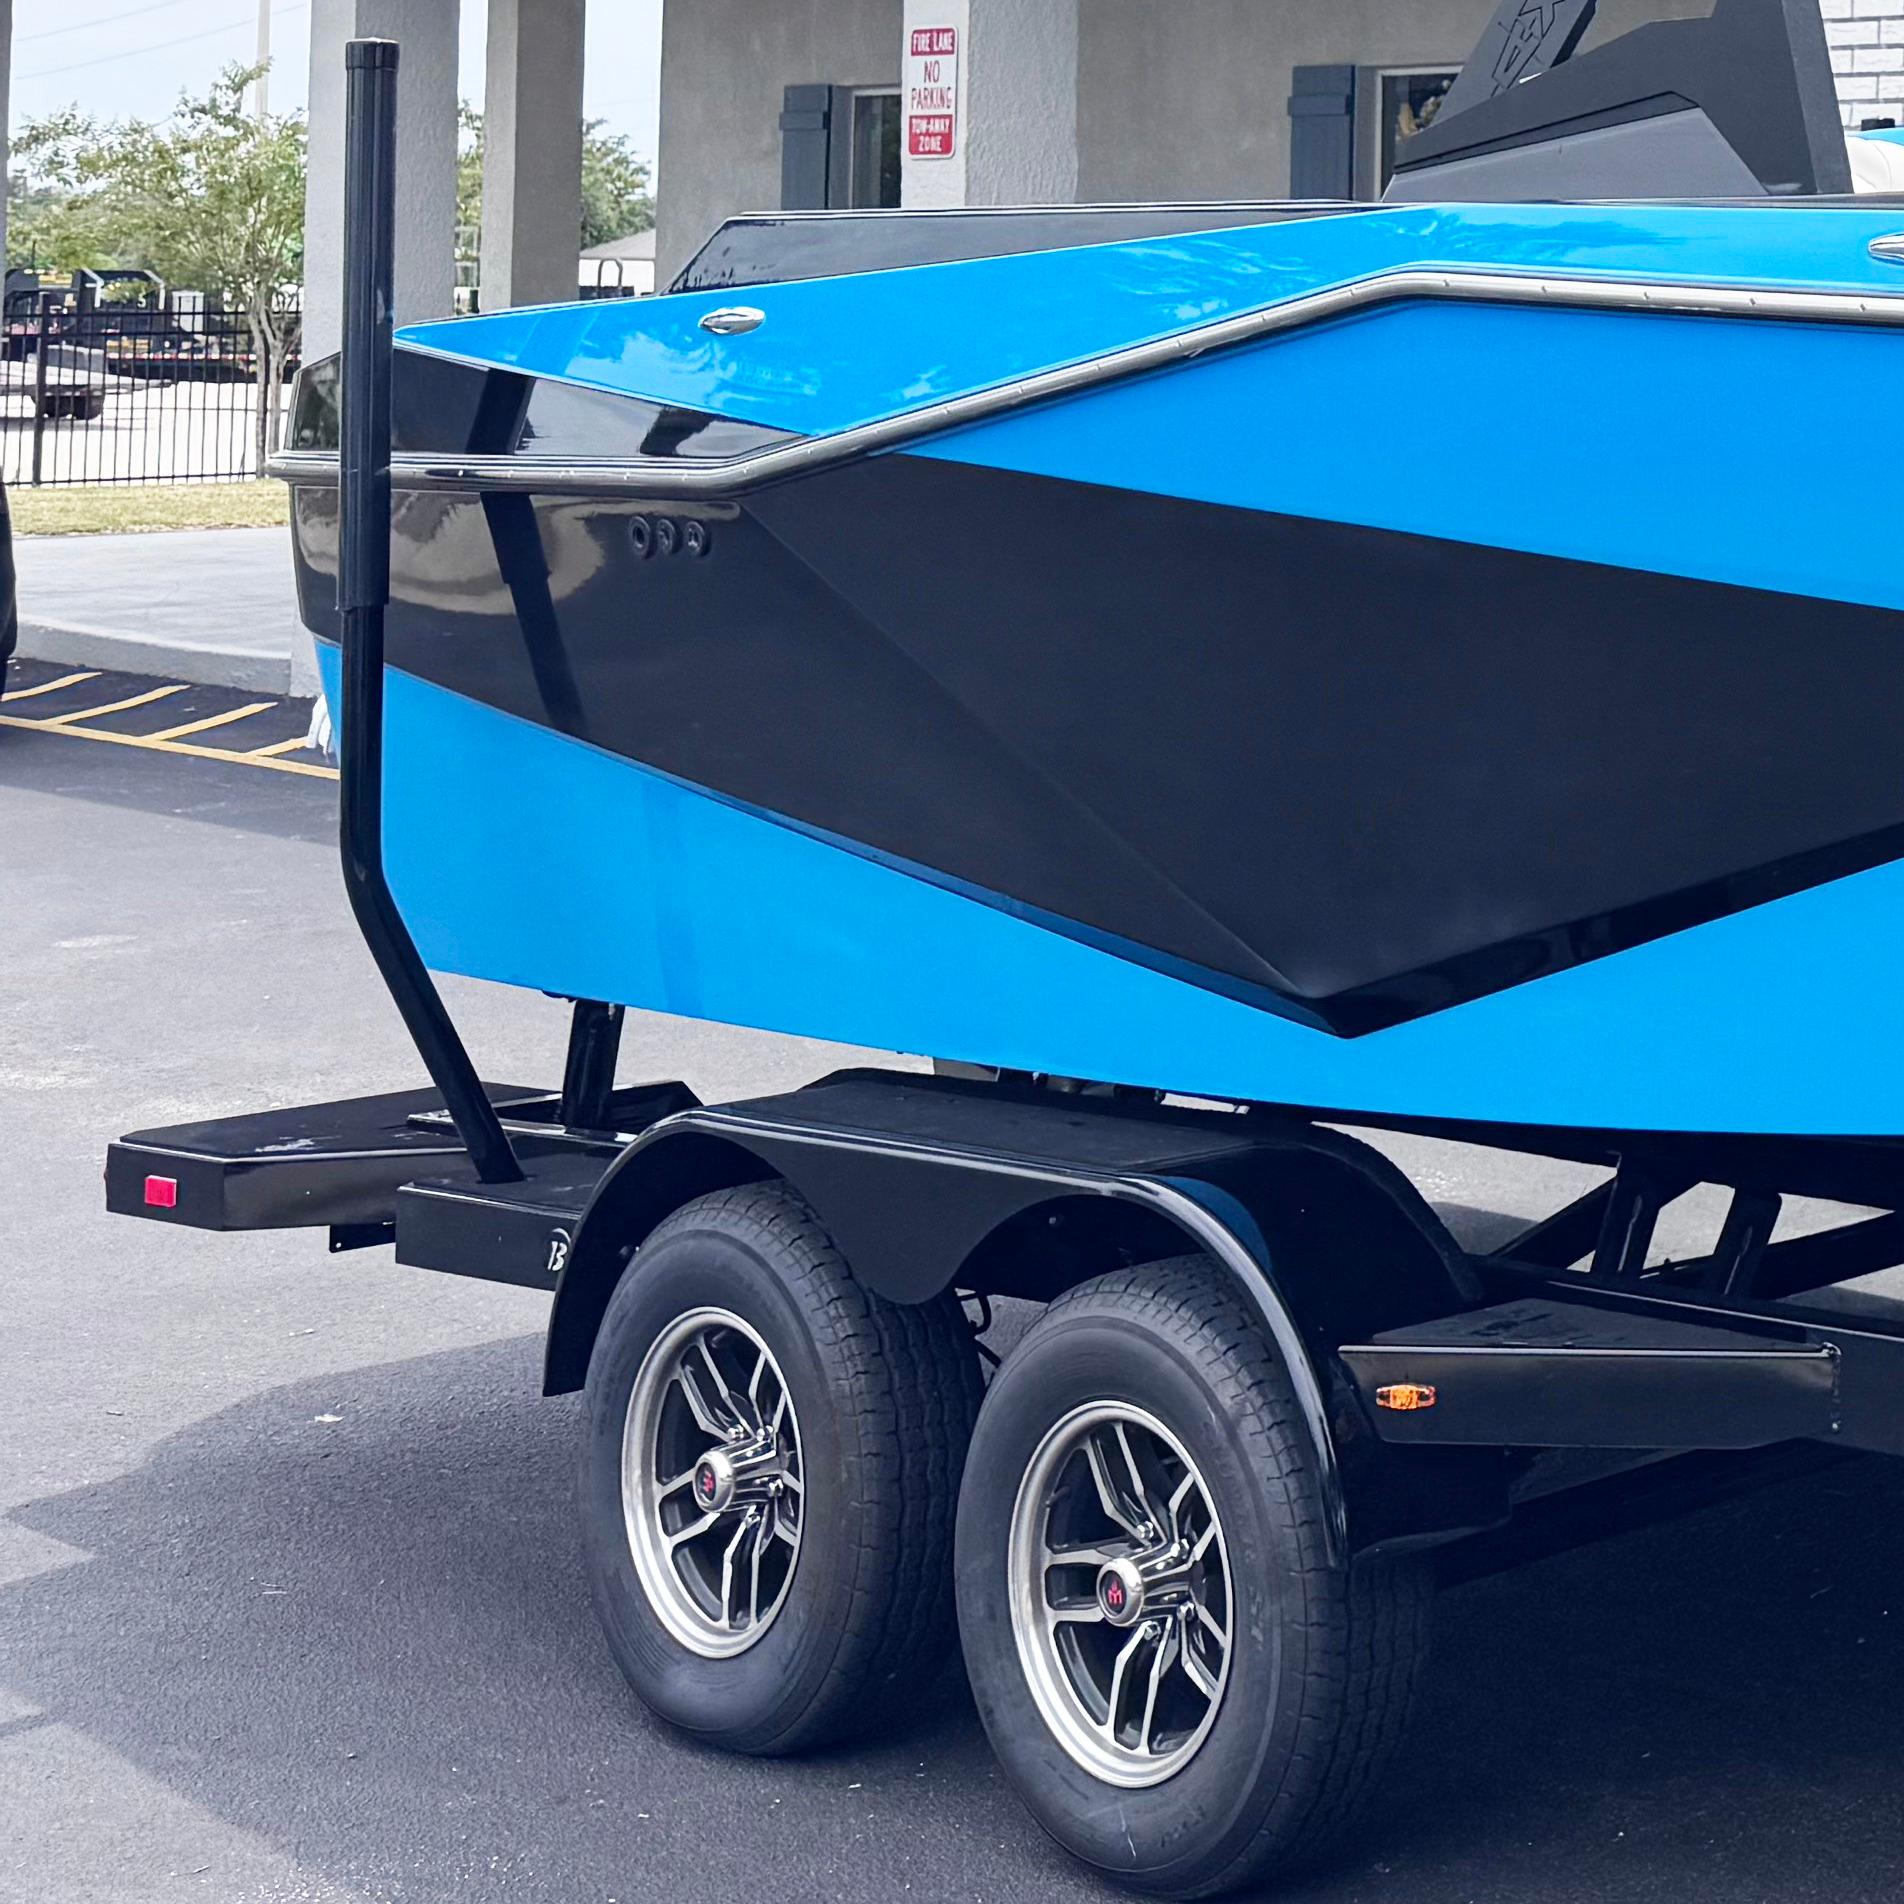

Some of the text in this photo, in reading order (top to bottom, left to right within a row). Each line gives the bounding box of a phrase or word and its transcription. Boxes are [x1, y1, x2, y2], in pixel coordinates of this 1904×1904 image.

[912, 30, 954, 52] FIRE LANE
[923, 60, 940, 84] NO
[911, 87, 952, 110] PARKING
[917, 135, 942, 152] ZONE
